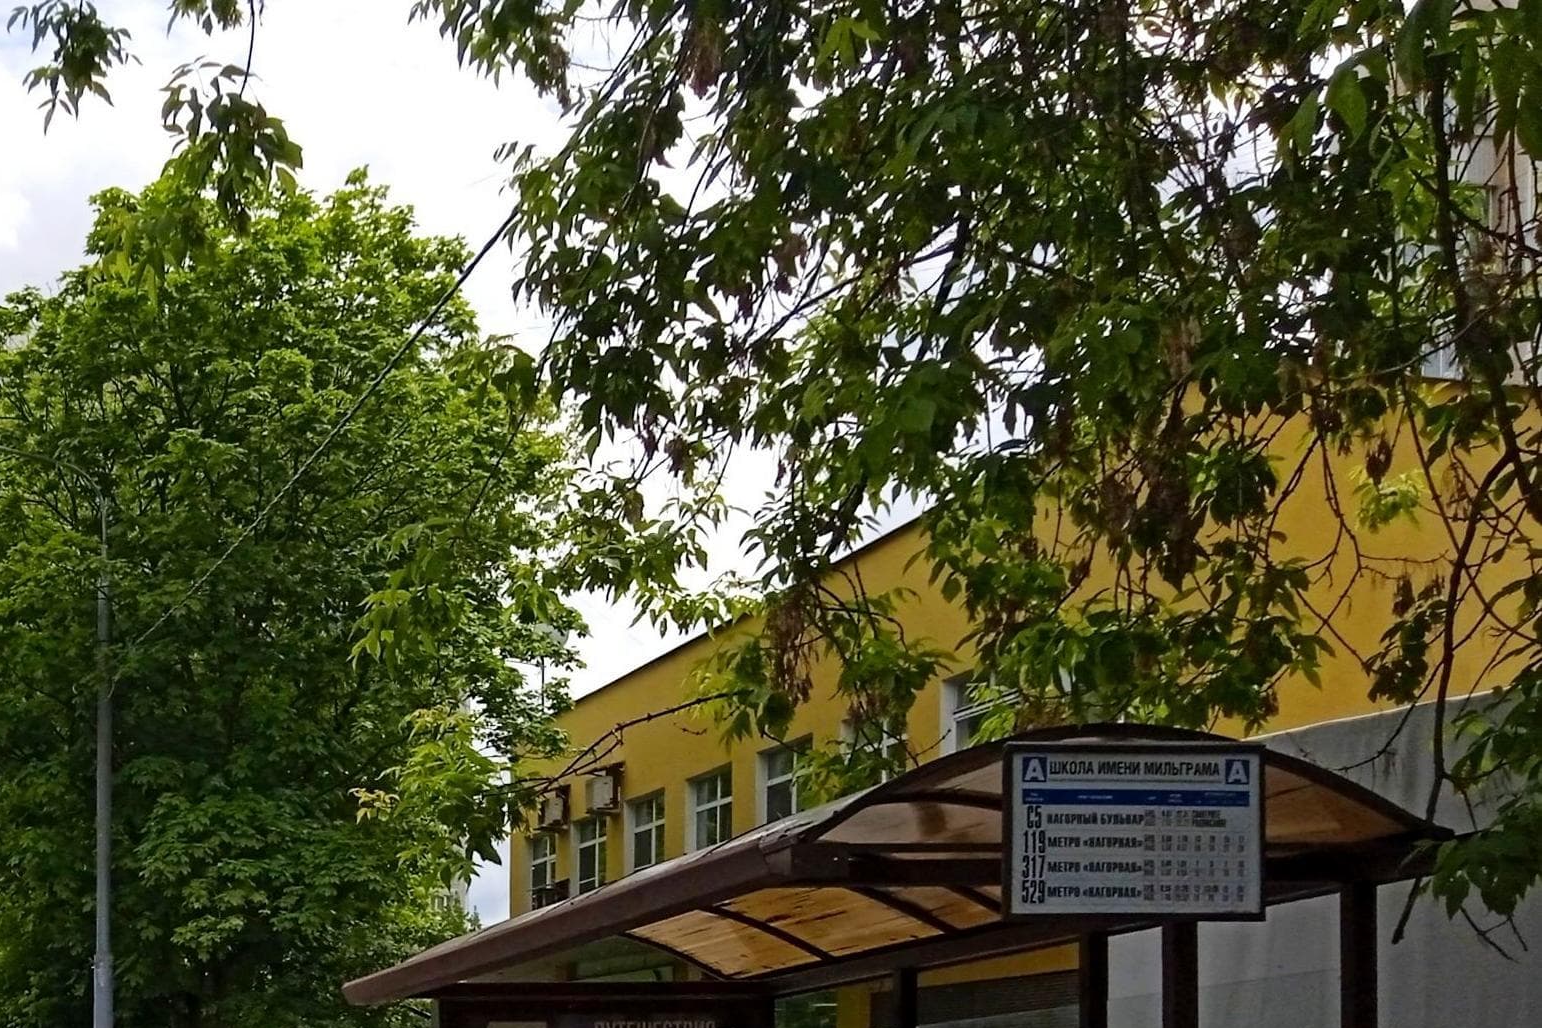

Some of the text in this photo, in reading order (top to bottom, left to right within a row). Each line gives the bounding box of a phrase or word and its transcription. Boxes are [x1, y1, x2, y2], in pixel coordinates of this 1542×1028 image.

[1049, 761, 1220, 776] ШКОЛА ИМЕНИ МИЛЬГРАМА
[1047, 812, 1098, 825] НАГОРНЫЙ
[1100, 814, 1144, 825] БУЛЬВАР
[1023, 830, 1046, 854] 119
[1047, 837, 1080, 848] МЕТРО
[1022, 855, 1046, 879] 317
[1047, 861, 1080, 873] МЕТРО
[1021, 880, 1046, 904] 529
[1047, 886, 1080, 898] МЕТРО
